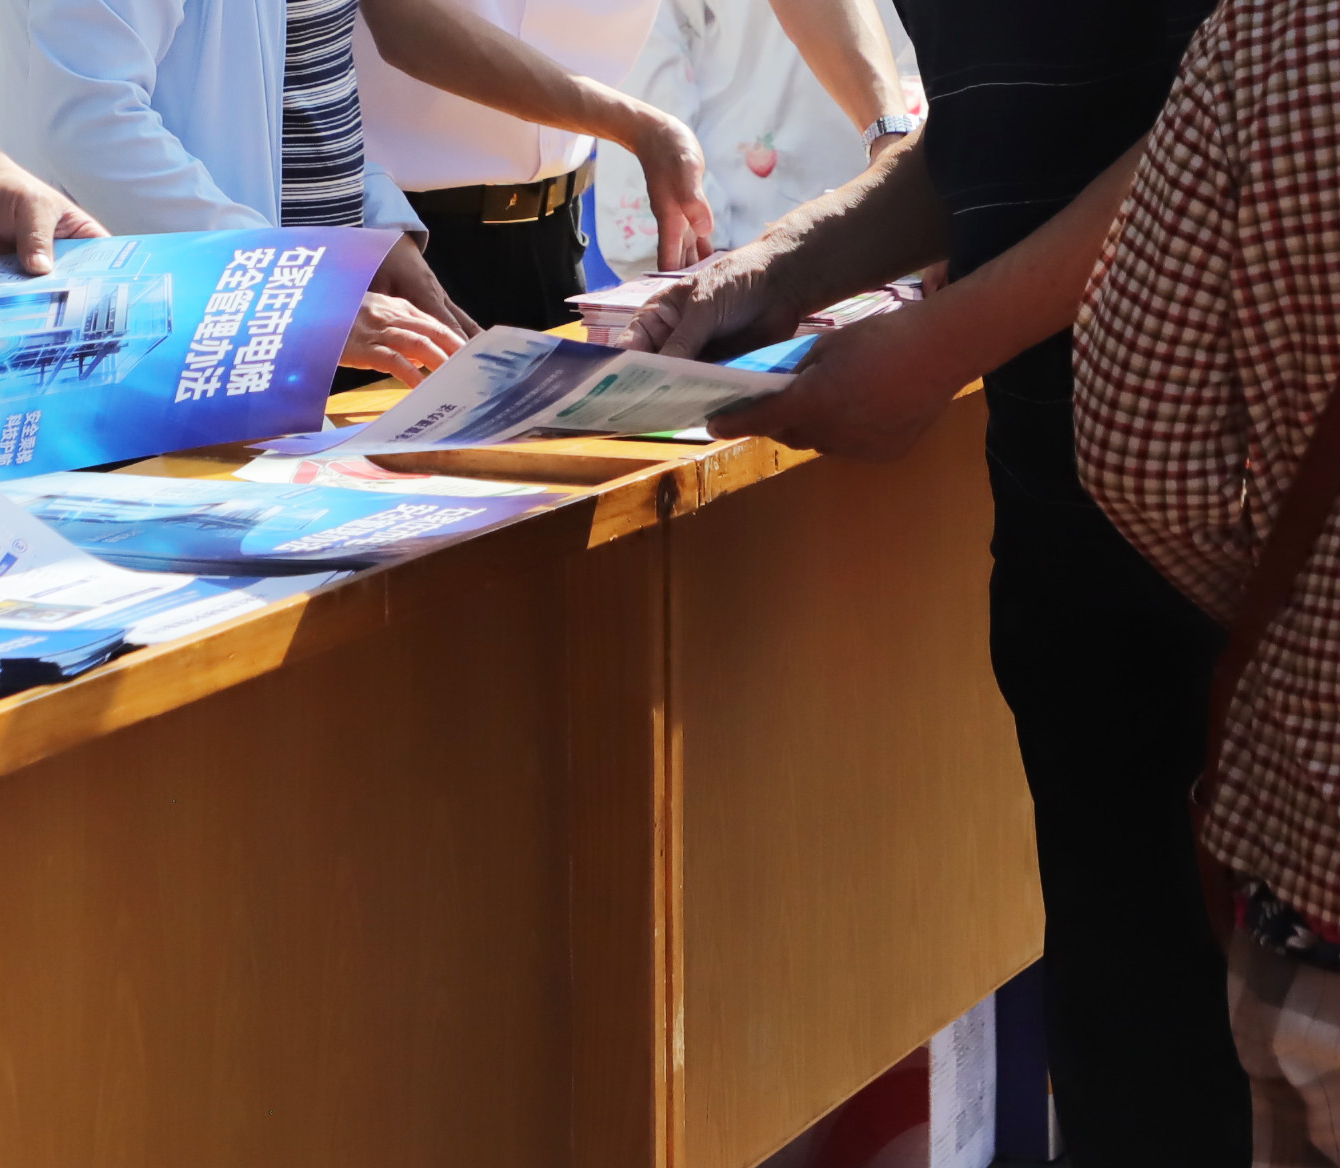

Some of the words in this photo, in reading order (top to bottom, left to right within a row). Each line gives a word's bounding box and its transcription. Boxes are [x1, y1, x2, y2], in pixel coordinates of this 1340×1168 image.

[174, 247, 276, 404] 安全管理办法
[226, 245, 327, 397] 石家庄市电梯
[15, 409, 42, 465] 安全乘梯
